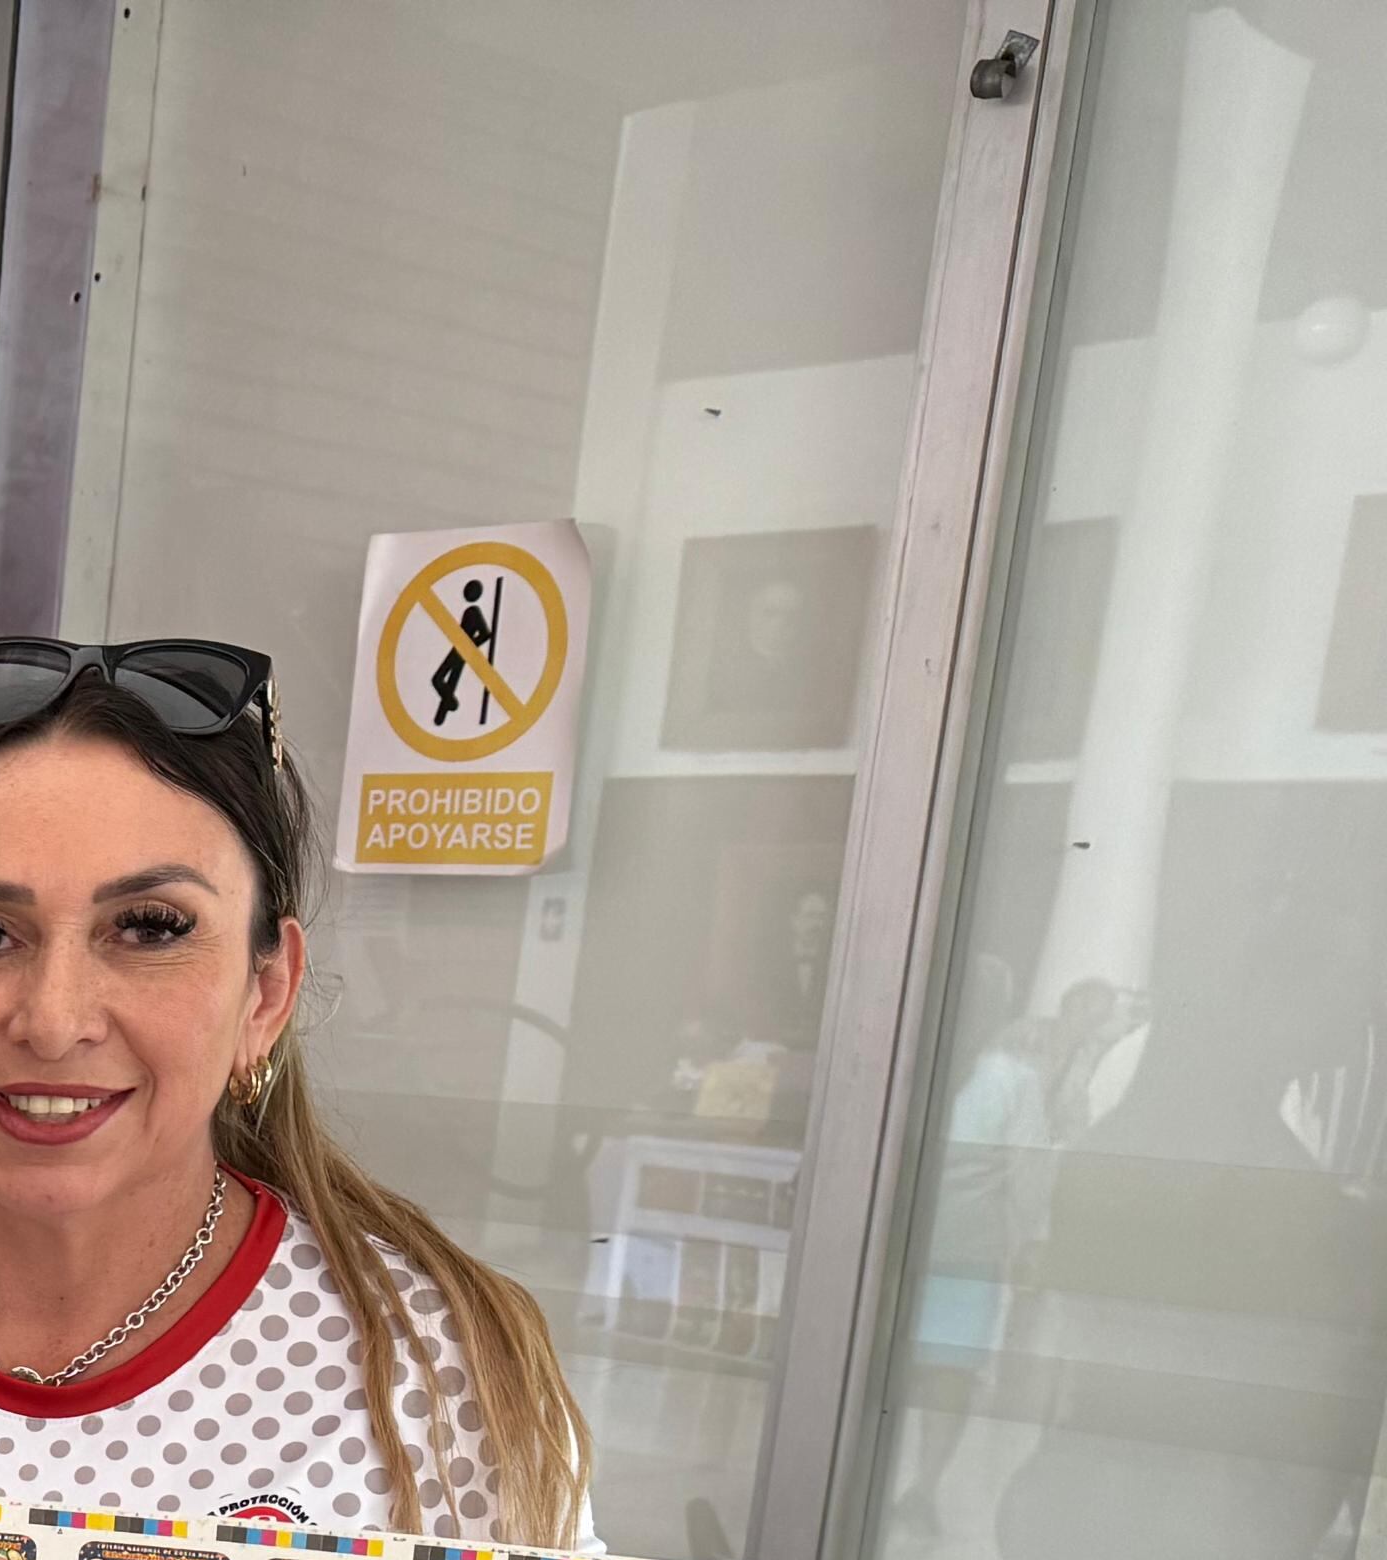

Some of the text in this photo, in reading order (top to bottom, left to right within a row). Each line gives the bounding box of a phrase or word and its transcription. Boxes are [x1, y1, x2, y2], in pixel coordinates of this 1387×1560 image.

[367, 788, 541, 815] PROHIBIDO
[365, 822, 535, 850] APOYARSE
[219, 1494, 309, 1524] PROTECCIÓN
